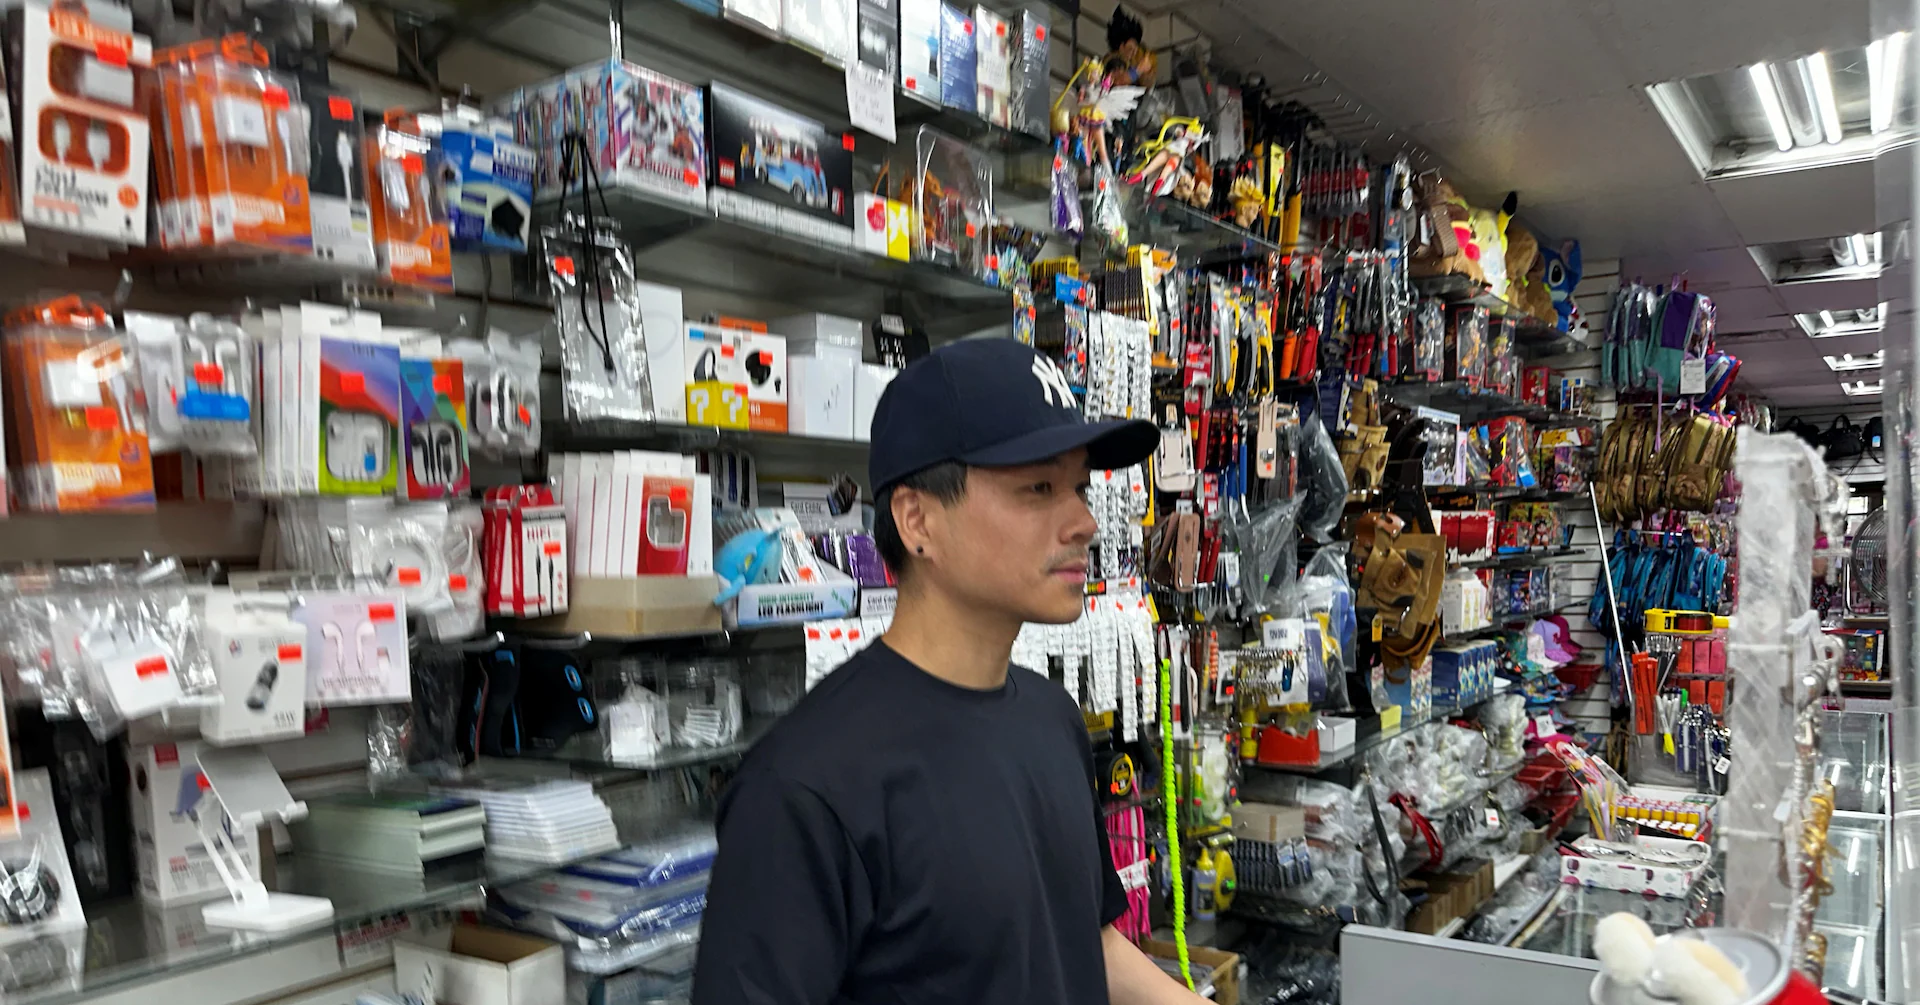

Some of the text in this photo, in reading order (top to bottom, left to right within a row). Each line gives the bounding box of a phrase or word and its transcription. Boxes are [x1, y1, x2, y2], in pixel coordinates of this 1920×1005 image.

[779, 592, 814, 603] INTENSITY
[758, 602, 824, 616] LED FLASHLIGHT
